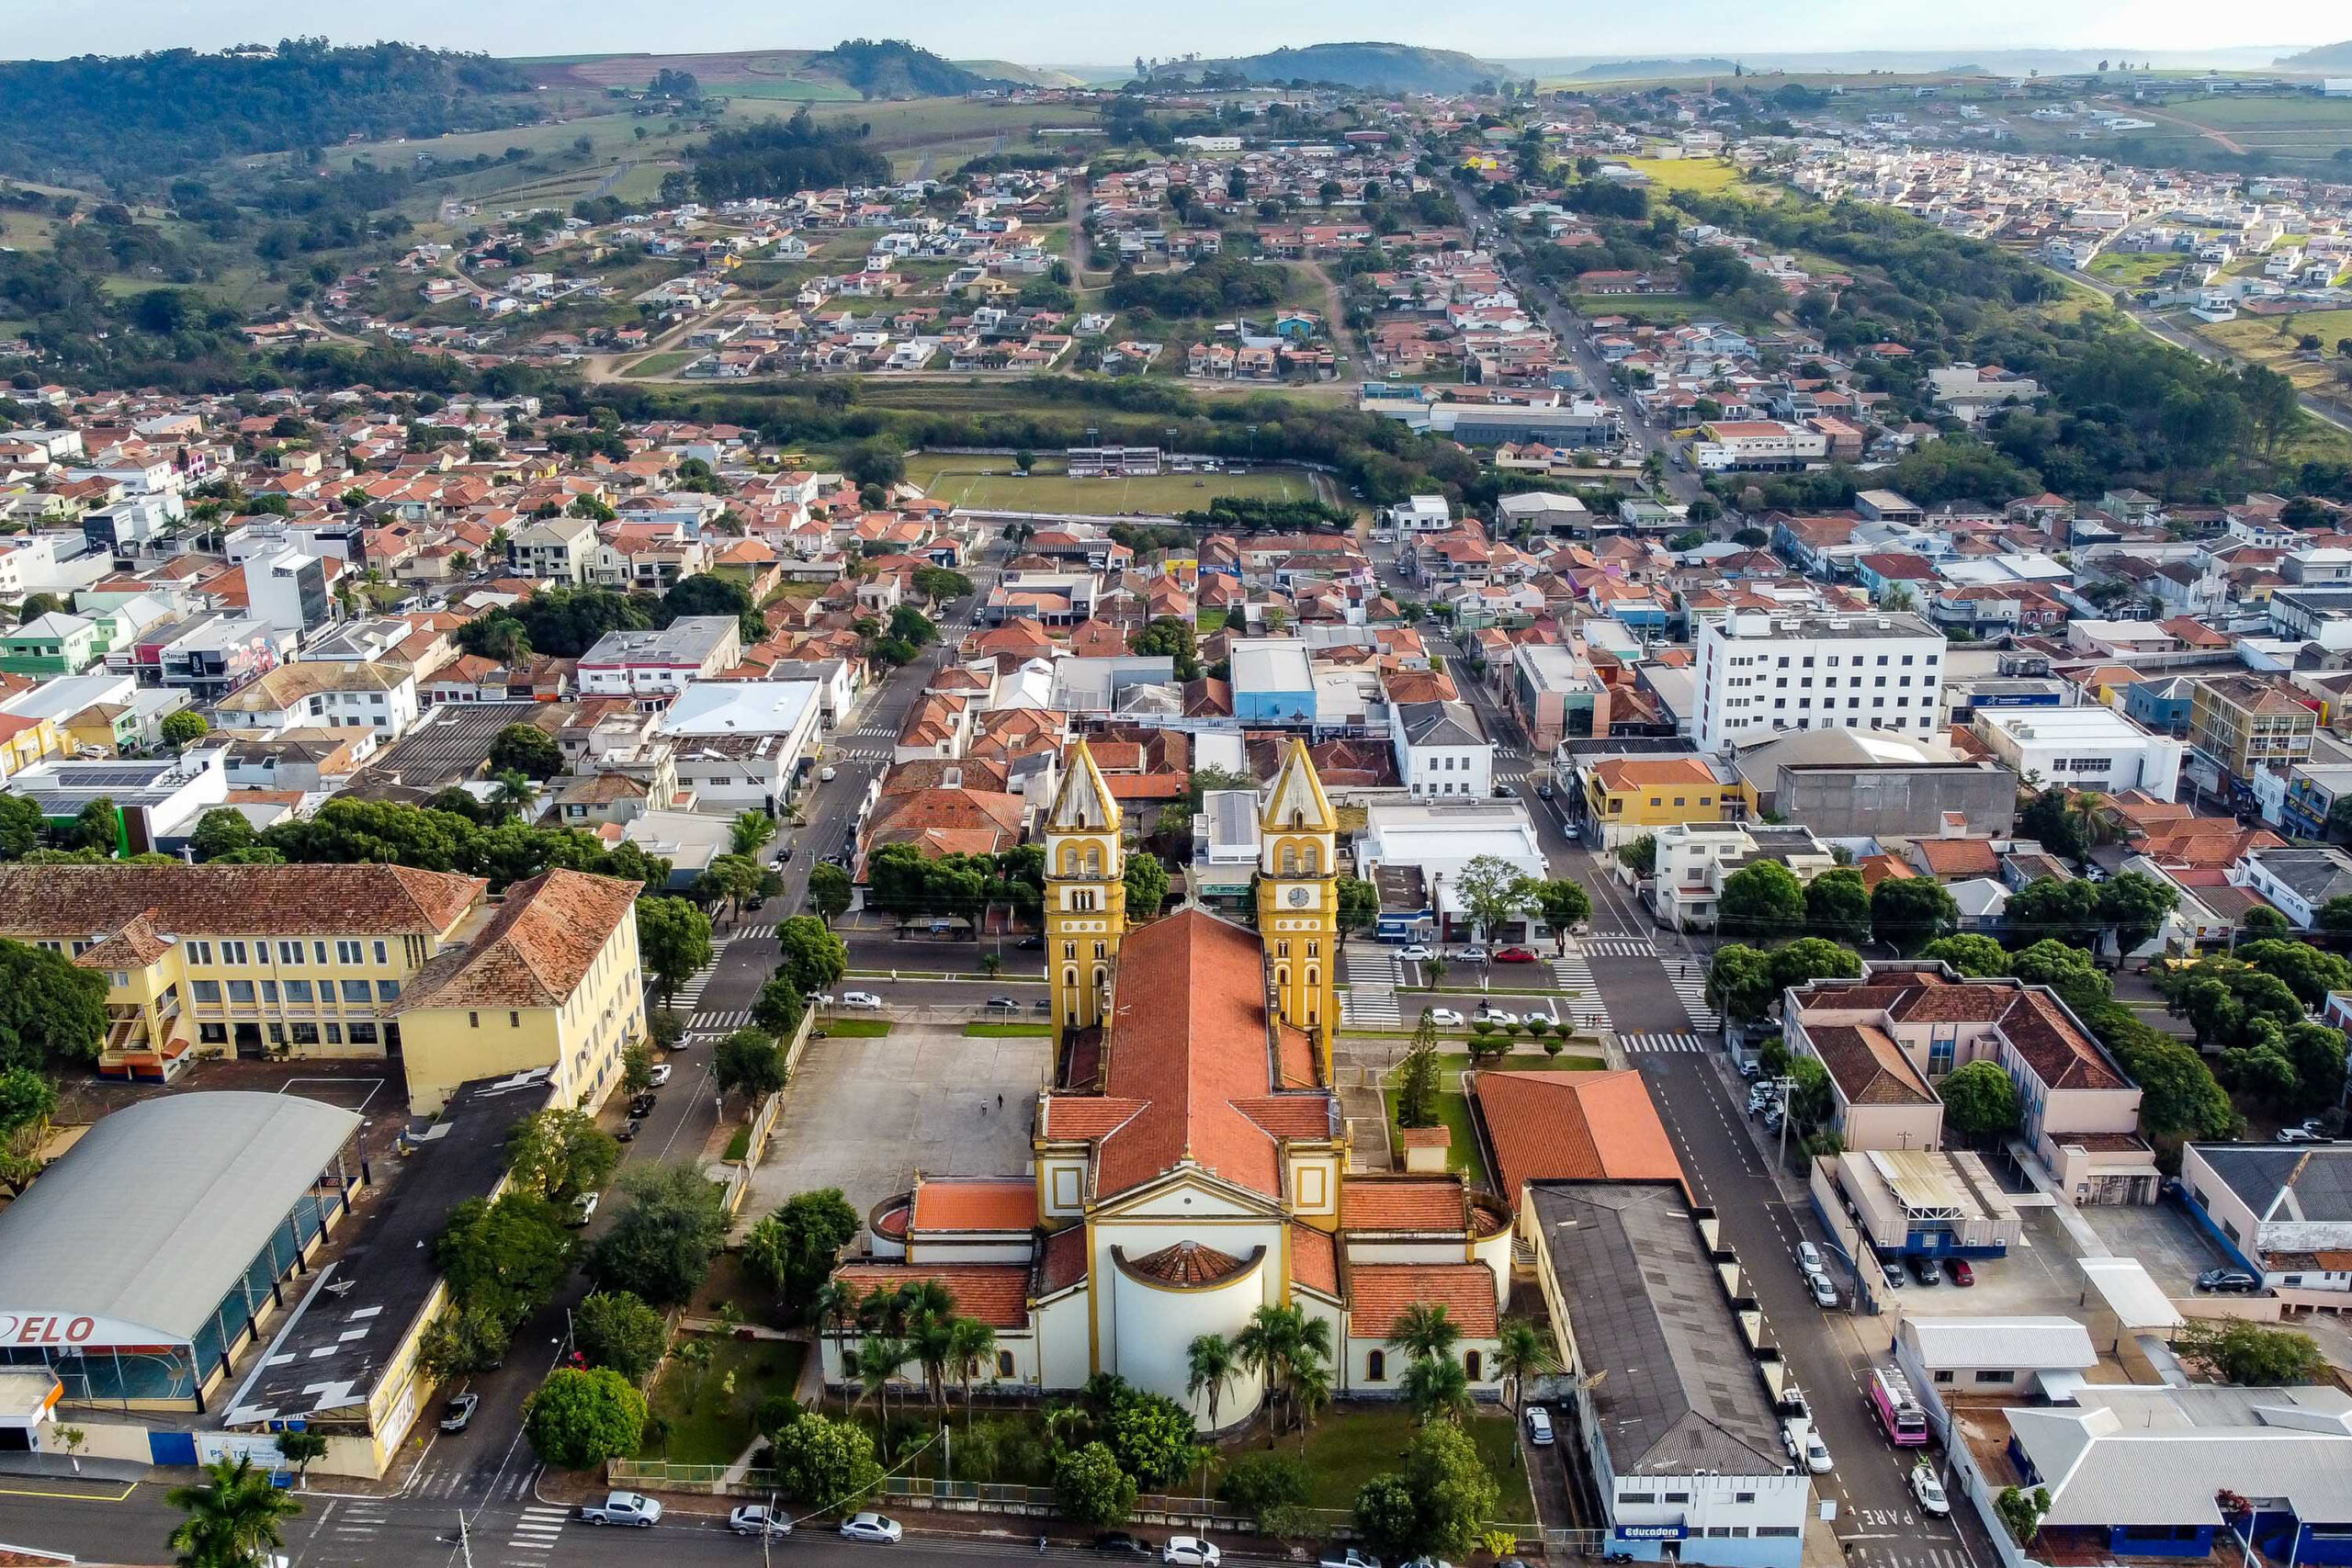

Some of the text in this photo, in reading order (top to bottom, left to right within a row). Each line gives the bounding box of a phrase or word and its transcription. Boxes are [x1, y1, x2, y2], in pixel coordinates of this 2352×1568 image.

[17, 1316, 95, 1342] ELO
[1861, 1509, 1915, 1525] PARE
[1625, 1528, 1679, 1536] Educadora
